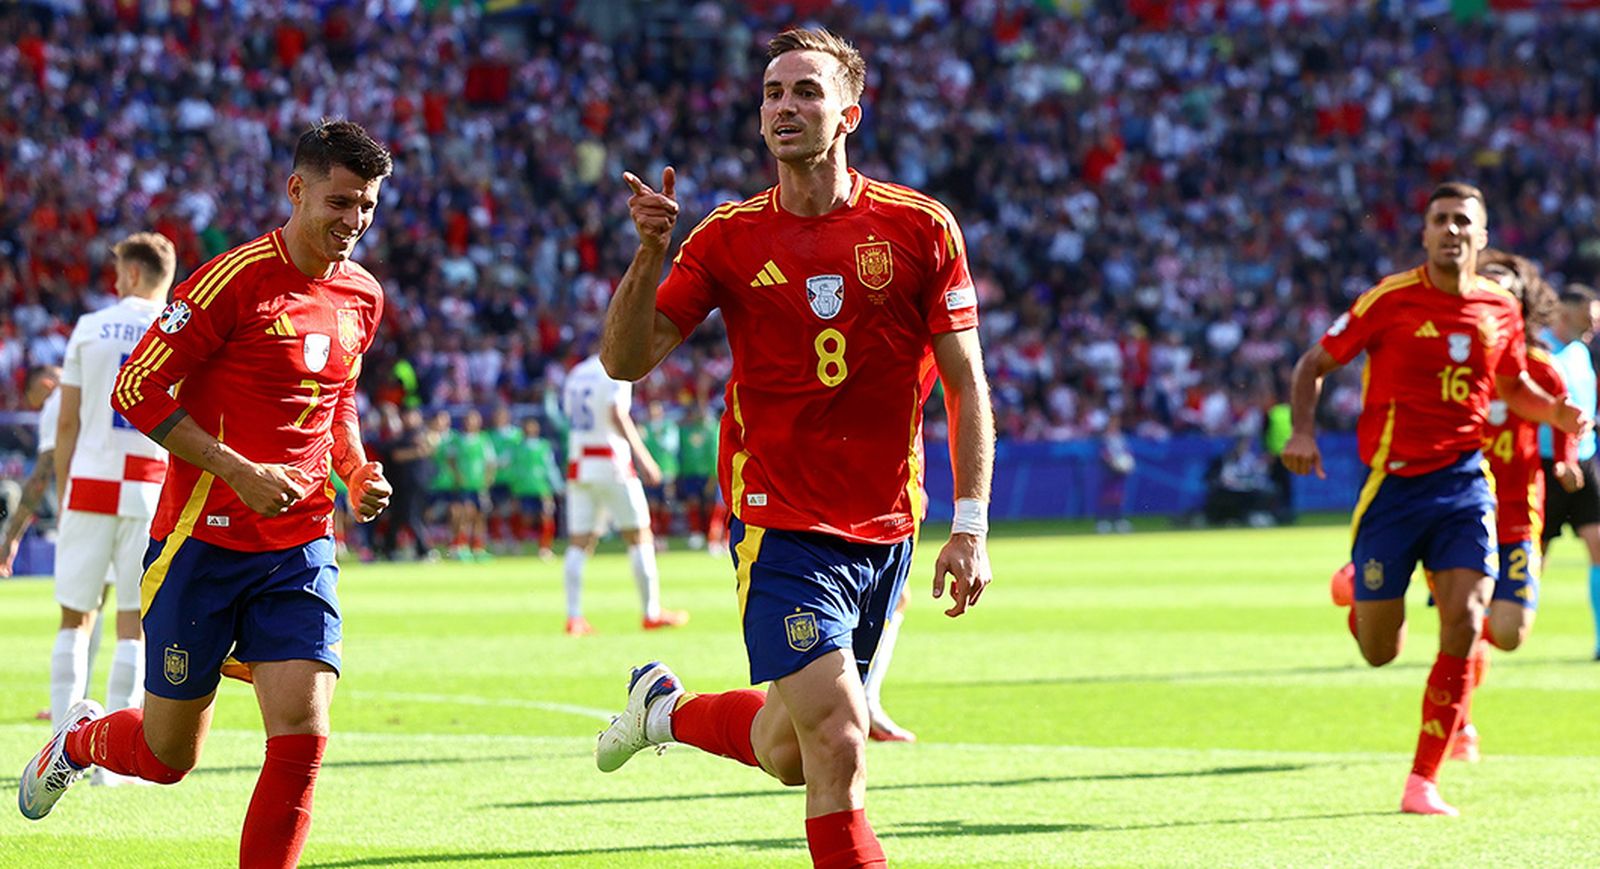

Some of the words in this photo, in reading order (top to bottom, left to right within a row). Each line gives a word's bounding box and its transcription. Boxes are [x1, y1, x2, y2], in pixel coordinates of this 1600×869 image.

[814, 328, 848, 387] 8
[294, 379, 320, 428] 7
[1438, 365, 1473, 401] 16
